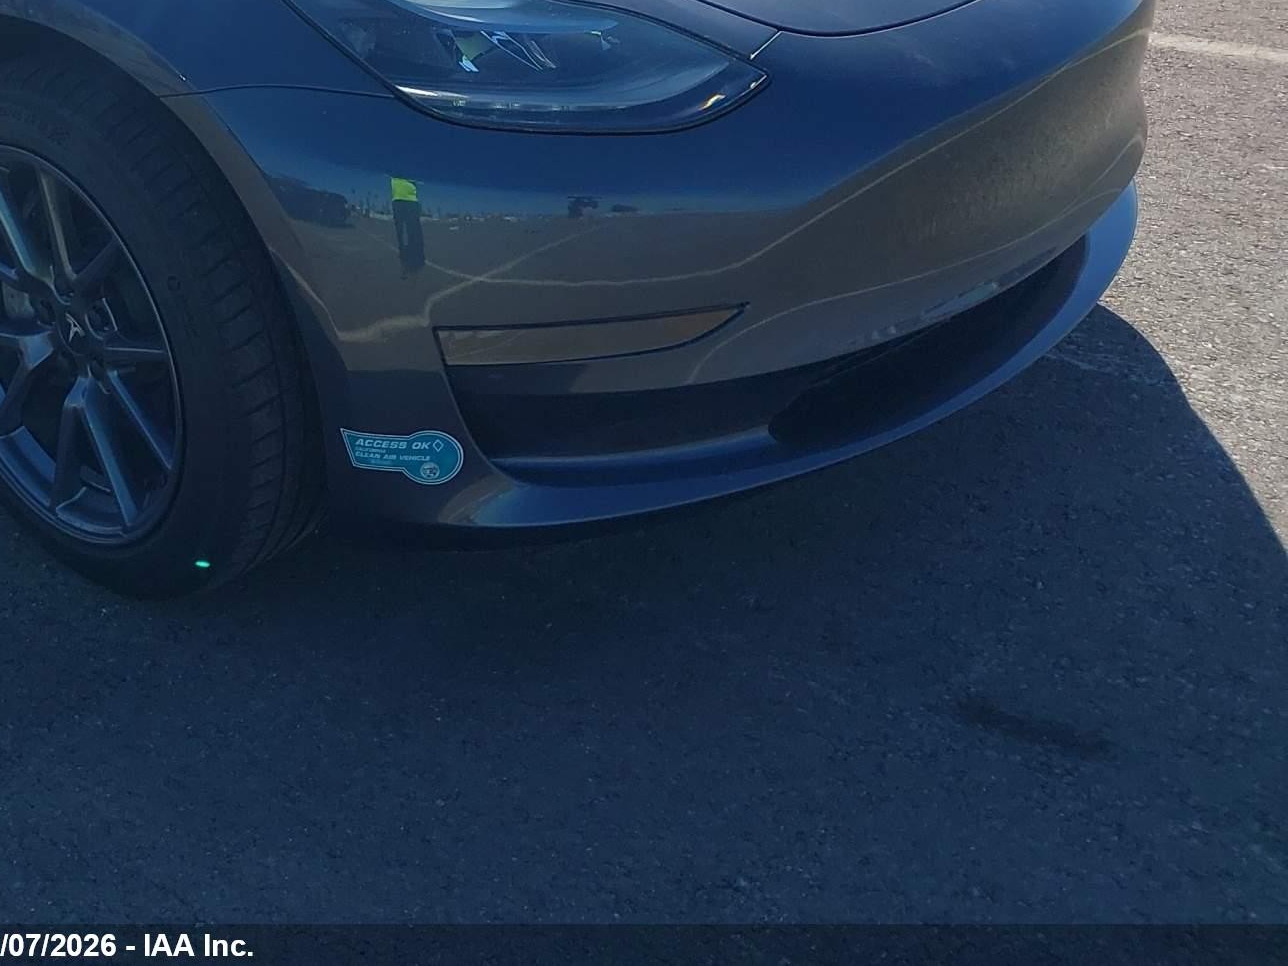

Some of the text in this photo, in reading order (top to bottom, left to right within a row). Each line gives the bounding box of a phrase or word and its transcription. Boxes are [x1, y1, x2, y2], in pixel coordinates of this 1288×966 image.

[355, 438, 431, 450] ACCESS OK
[355, 451, 381, 459] CLEAN
